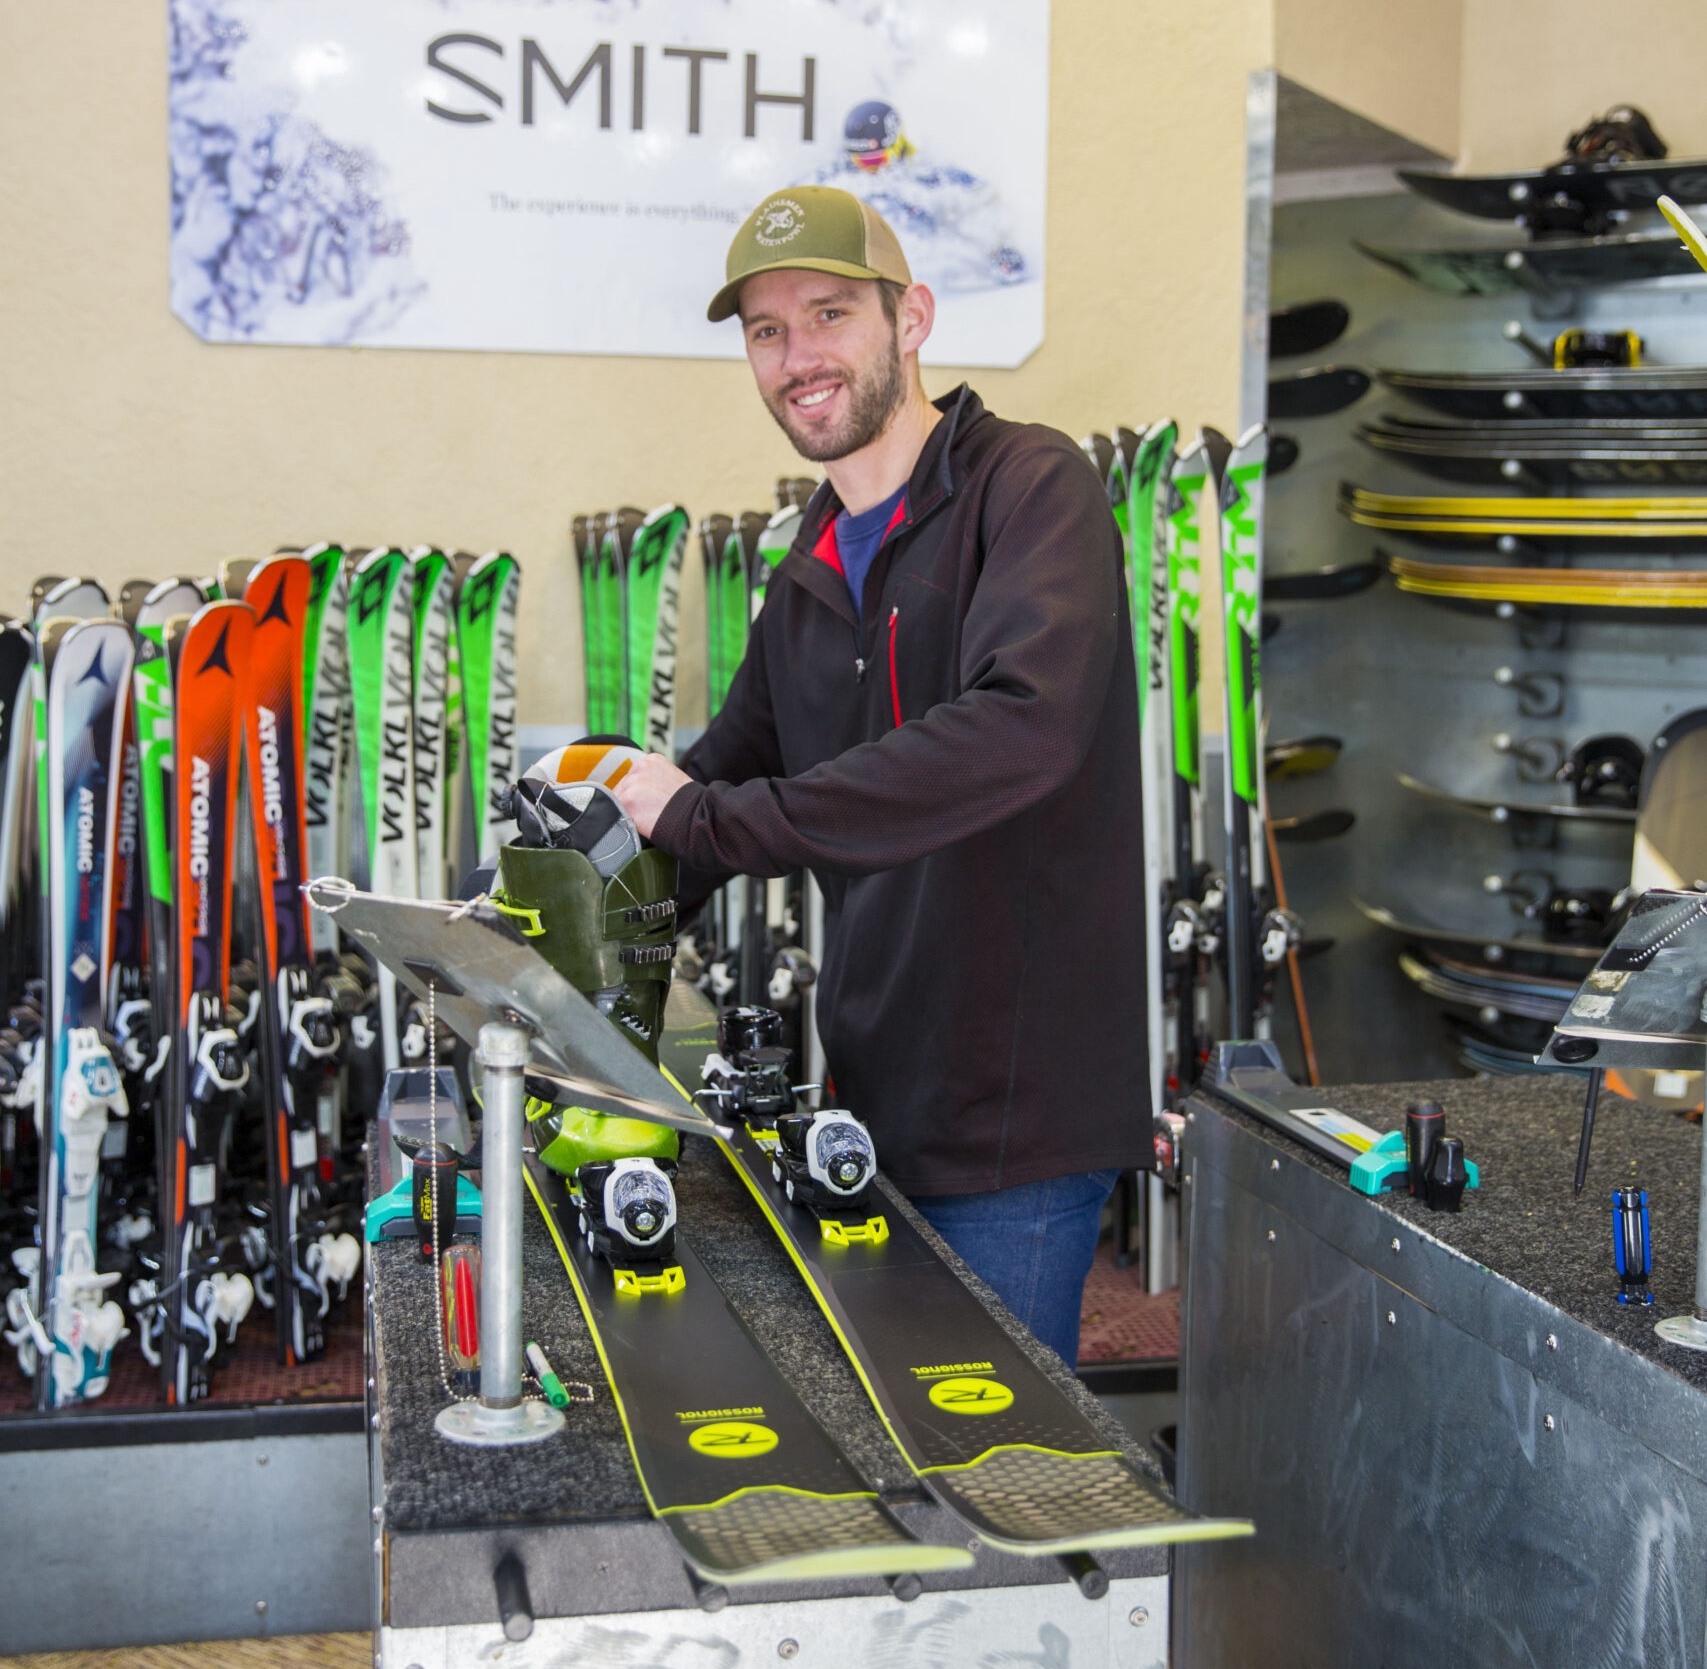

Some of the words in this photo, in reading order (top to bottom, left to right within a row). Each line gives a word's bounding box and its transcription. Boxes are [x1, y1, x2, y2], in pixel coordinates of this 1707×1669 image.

[426, 32, 816, 141] SMITH
[488, 190, 520, 212] The
[526, 196, 620, 219] experience
[624, 198, 641, 216] is
[117, 742, 139, 854] ATOMIC
[257, 705, 282, 826] ATOMIC
[77, 786, 94, 873] ATOMIC
[190, 755, 210, 878] ATOMIC
[422, 1178, 431, 1220] FatMax
[909, 1361, 994, 1374] ROSSIGNOL
[675, 1406, 764, 1419] ROSSIGNOL
